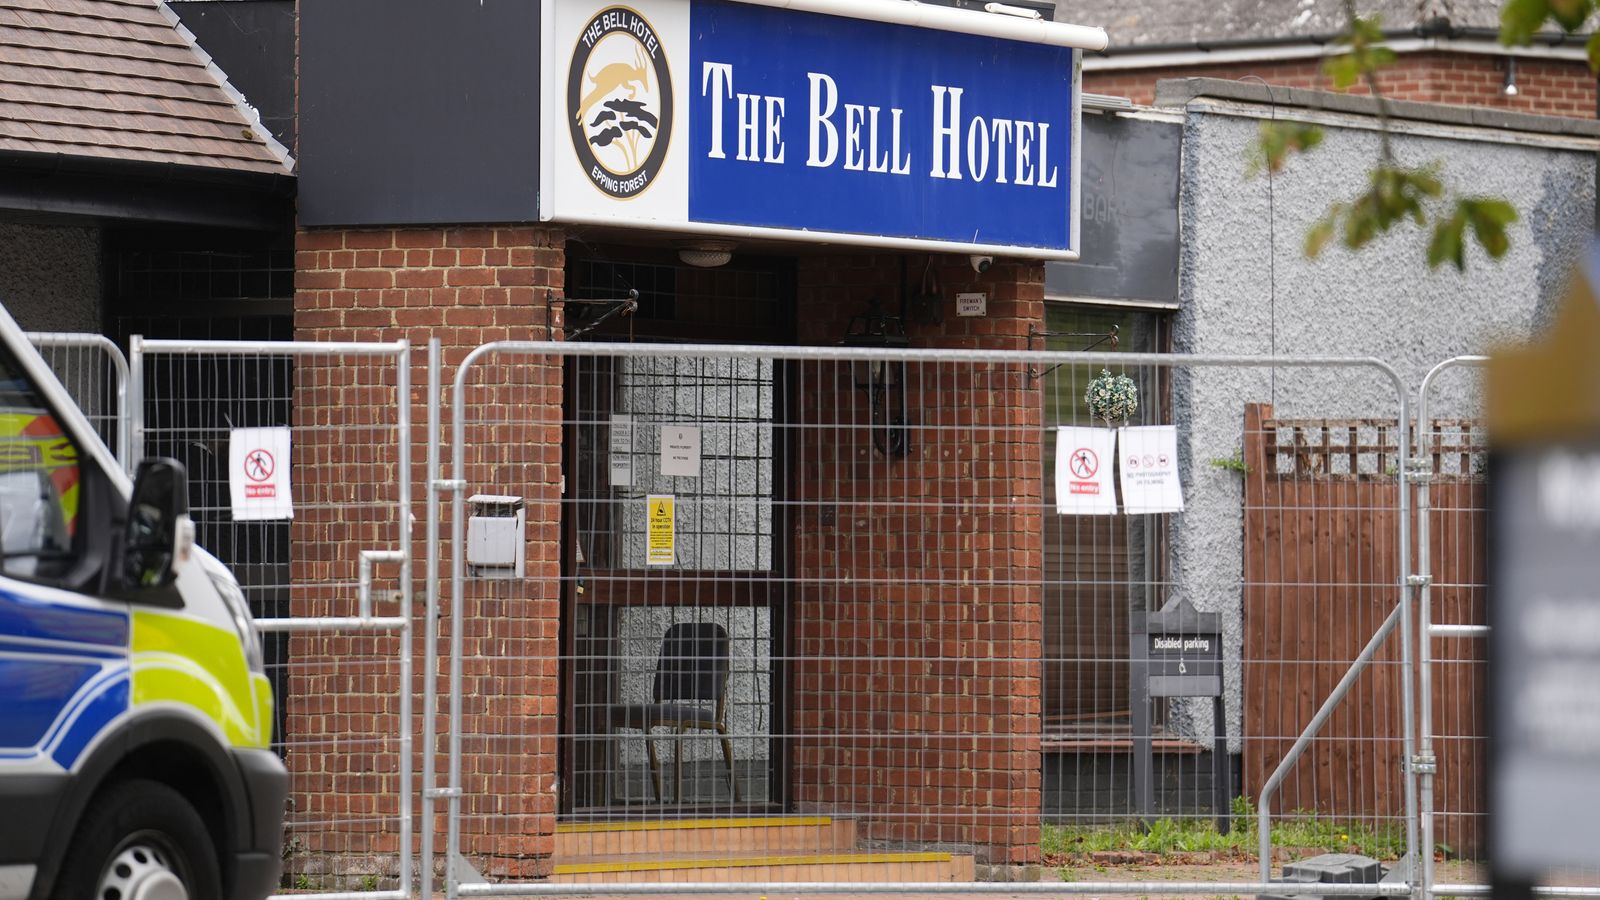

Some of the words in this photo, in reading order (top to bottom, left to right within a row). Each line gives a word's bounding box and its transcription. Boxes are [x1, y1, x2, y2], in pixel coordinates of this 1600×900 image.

[582, 20, 603, 48] THE
[602, 12, 628, 31] BELL
[630, 16, 659, 59] HOTEL
[702, 61, 785, 164] THE
[806, 72, 911, 175] BELL
[930, 85, 1058, 188] HOTEL
[591, 165, 618, 193] EPPING
[619, 170, 648, 193] FOREST
[1154, 637, 1182, 649] Disabled
[1184, 637, 1209, 651] parking
